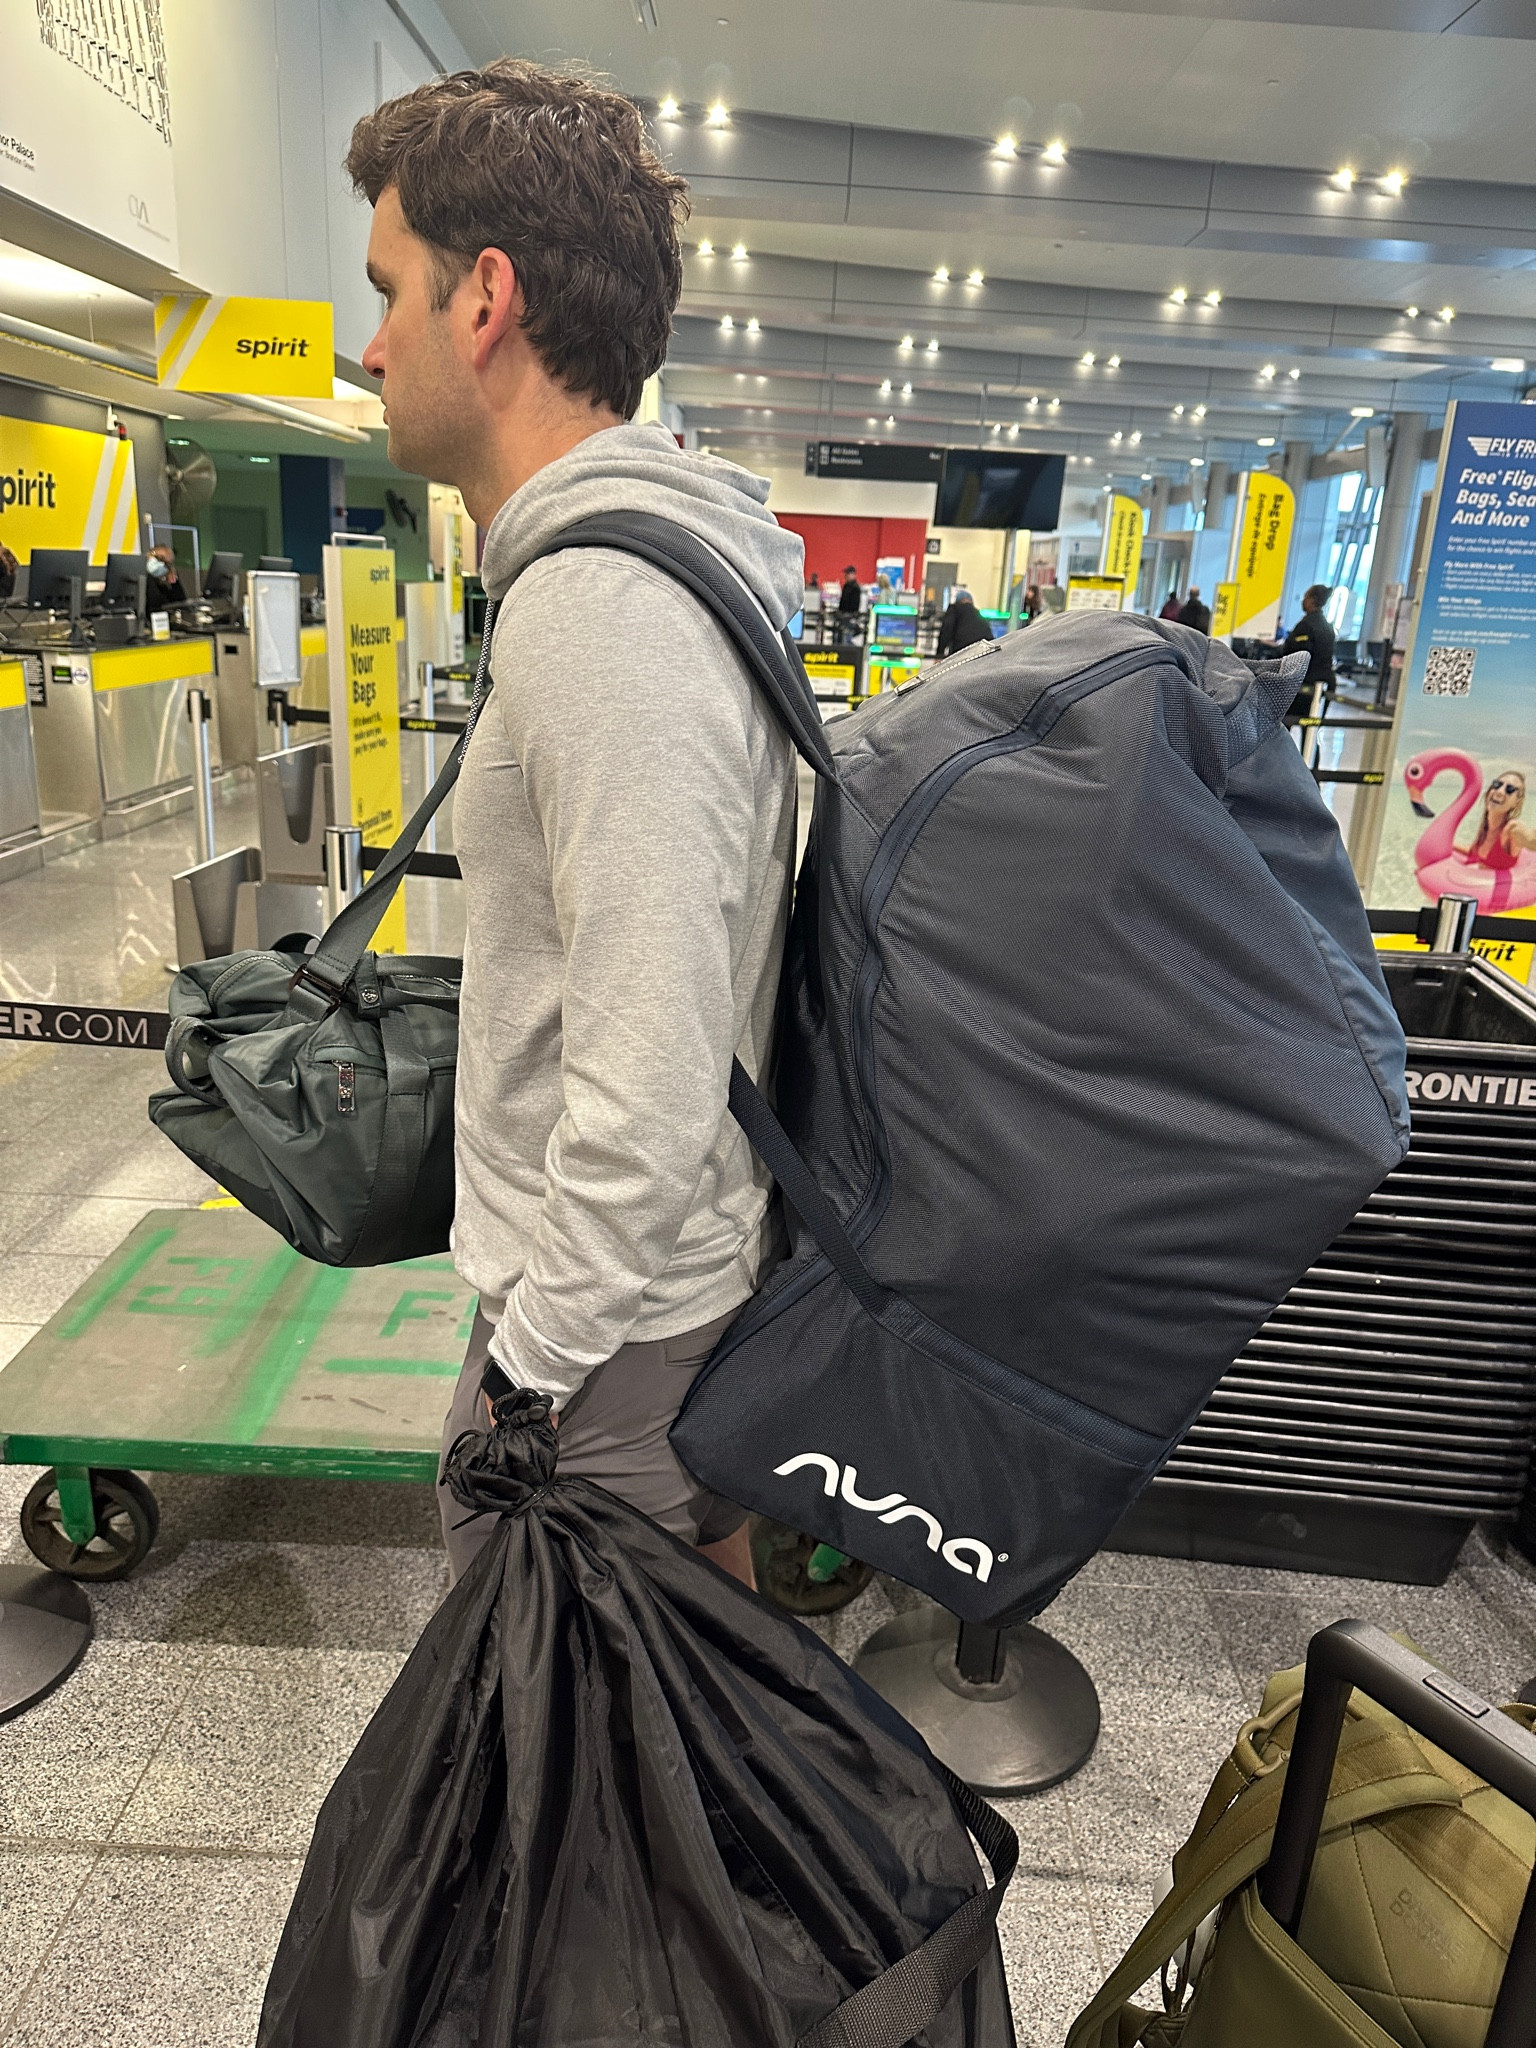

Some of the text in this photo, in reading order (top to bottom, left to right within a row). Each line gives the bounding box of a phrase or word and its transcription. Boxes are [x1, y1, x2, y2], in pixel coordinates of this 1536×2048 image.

[11, 137, 35, 160] Palace
[236, 337, 310, 358] spirit
[1490, 437, 1517, 452] FLY
[0, 469, 56, 514] pirit
[1455, 488, 1502, 510] Bags,
[1265, 493, 1285, 551] Bag Drop
[1451, 508, 1531, 528] And More
[370, 565, 391, 584] spirit
[350, 623, 392, 648] Measure
[351, 652, 374, 676] Your
[803, 649, 839, 665] spirit
[353, 680, 377, 708] Bags
[407, 720, 436, 730] spirit
